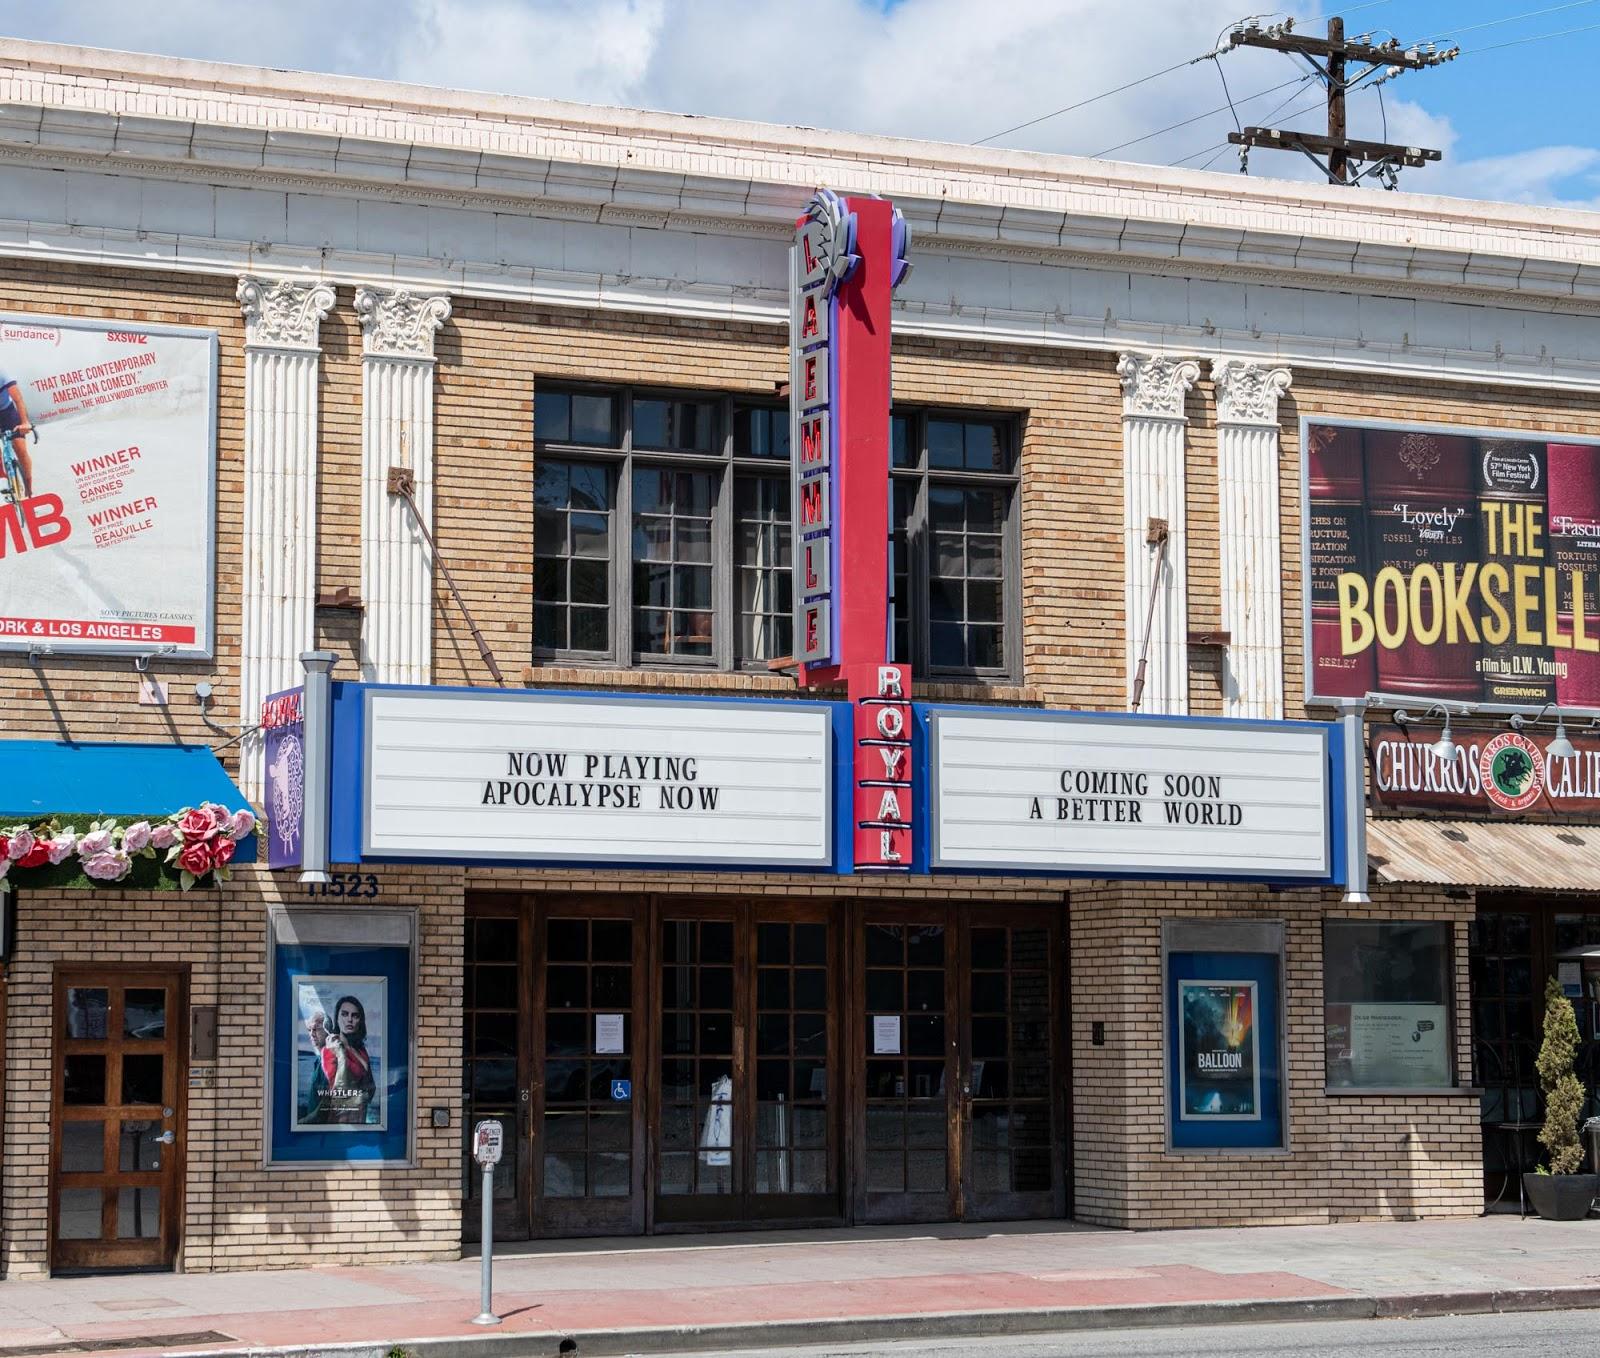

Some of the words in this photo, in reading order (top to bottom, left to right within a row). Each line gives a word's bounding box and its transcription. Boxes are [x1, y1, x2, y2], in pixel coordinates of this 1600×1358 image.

[4, 329, 55, 341] sundance
[59, 370, 85, 387] RARE
[85, 352, 157, 380] CONTEMPORARY
[52, 382, 101, 404] AMERICAN
[81, 400, 95, 408] THE
[95, 388, 135, 405] HOLLYWOOD
[134, 380, 169, 395] REPORTER
[800, 233, 822, 652] LAEMMLE
[70, 446, 141, 477] WINNER
[1503, 463, 1517, 471] New
[1517, 464, 1532, 472] York
[1506, 471, 1531, 479] Festival
[79, 479, 124, 499] CANNES
[87, 496, 158, 527] WINNER
[1392, 503, 1465, 532] “Lovely”
[94, 519, 154, 544] DEAUVILLE
[1383, 533, 1413, 543] FOSSIL
[1481, 502, 1545, 558] THE
[1415, 548, 1429, 557] OF
[1556, 551, 1598, 561] TORTUES
[1557, 562, 1598, 572] FOSSILES
[100, 609, 122, 617] SONY
[121, 610, 158, 619] PICTURES
[159, 612, 193, 621] CLASSICS
[32, 621, 44, 634] &
[49, 622, 82, 636] LOS
[86, 624, 163, 640] ANGELES
[1475, 660, 1481, 672] a
[1482, 657, 1499, 673] film
[1500, 659, 1511, 676] by
[1512, 656, 1535, 674] D.W.
[1536, 657, 1568, 679] Young
[1493, 686, 1547, 697] GREENWICH
[507, 752, 567, 777] NOW
[584, 754, 698, 781] PLAYING
[876, 666, 904, 860] ROYAL
[1376, 740, 1480, 796] CHURROS
[1481, 735, 1511, 790] CHURROS
[481, 780, 642, 809] APOCALYPSE
[659, 785, 720, 810] NOW
[1060, 769, 1149, 796] COMING
[1164, 774, 1222, 798] SOON
[1029, 796, 1043, 819] A
[1056, 797, 1143, 823] BETTER
[1163, 801, 1243, 826] WORLD
[1197, 1052, 1243, 1069] BALLOON
[317, 1089, 363, 1097] WHISTLERS
